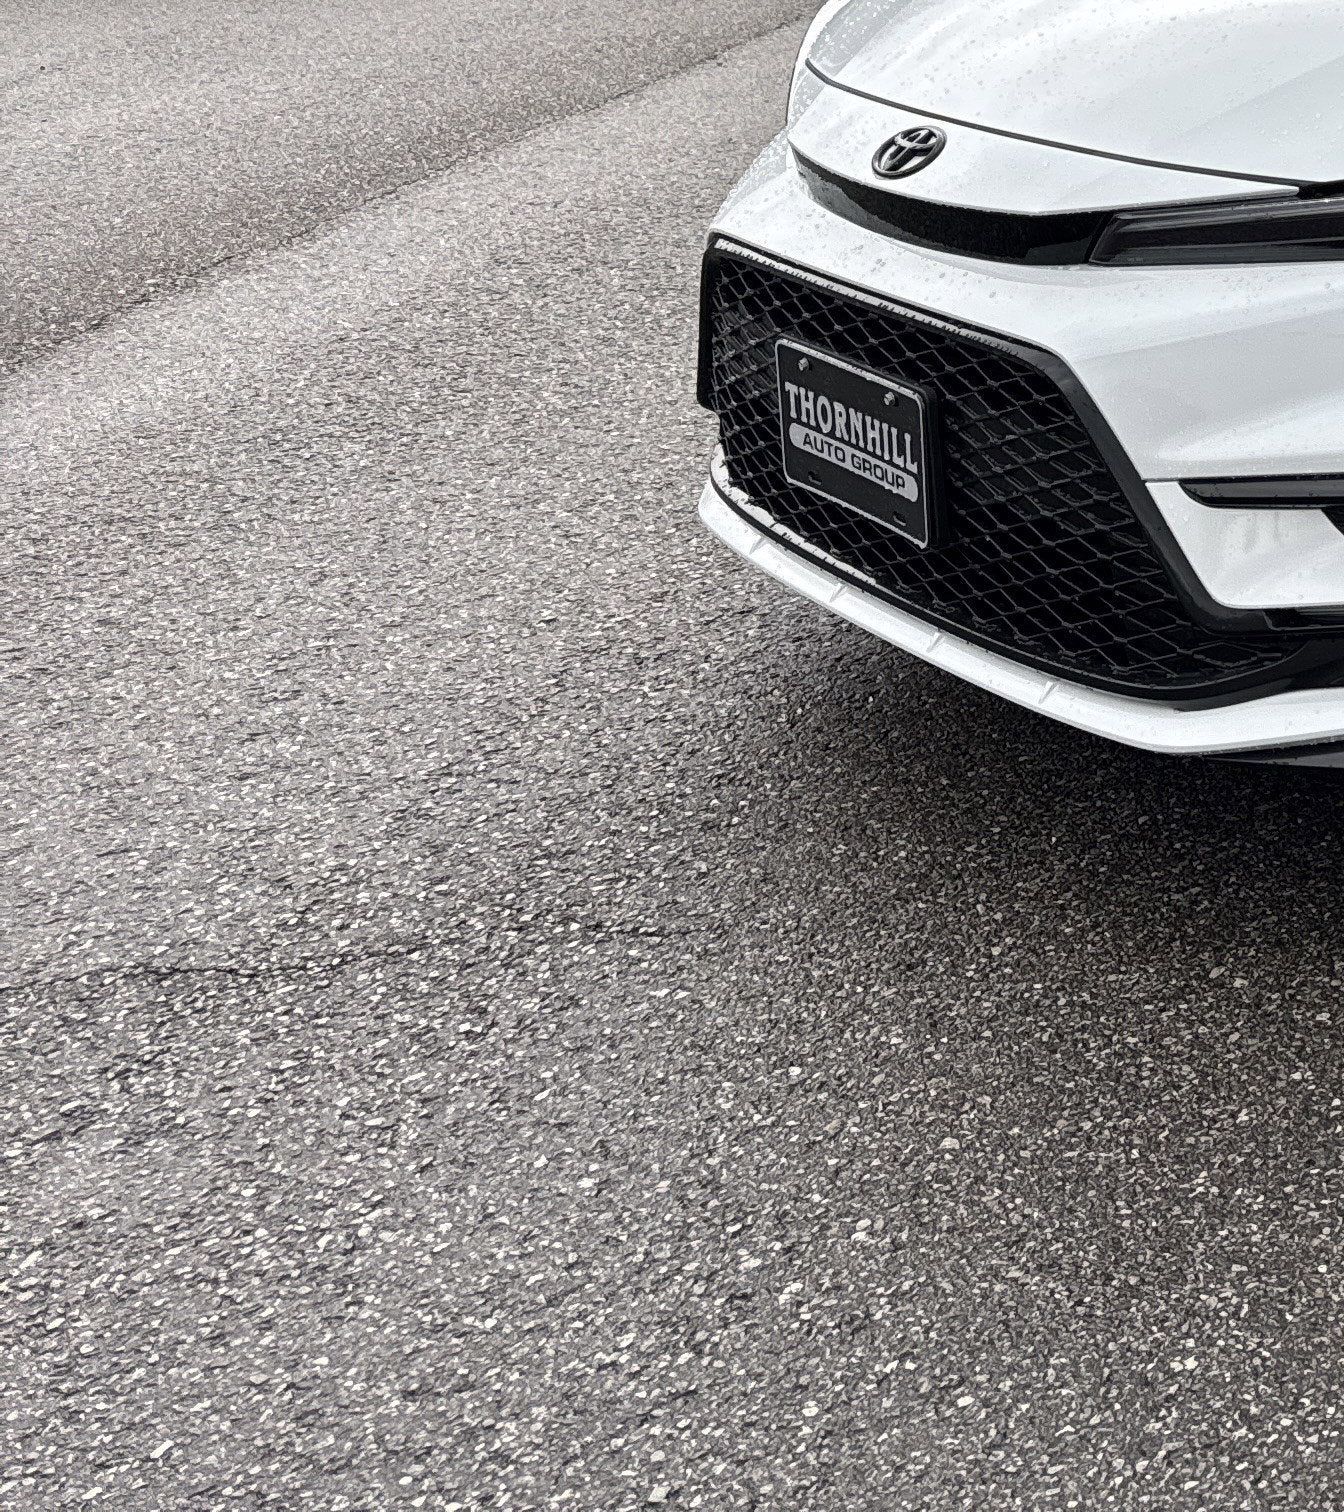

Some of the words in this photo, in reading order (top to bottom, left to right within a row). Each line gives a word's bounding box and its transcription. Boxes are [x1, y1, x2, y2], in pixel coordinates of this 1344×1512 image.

[784, 381, 918, 475] THORNHILL
[802, 432, 846, 463] AUTO
[850, 452, 906, 489] GROUP
